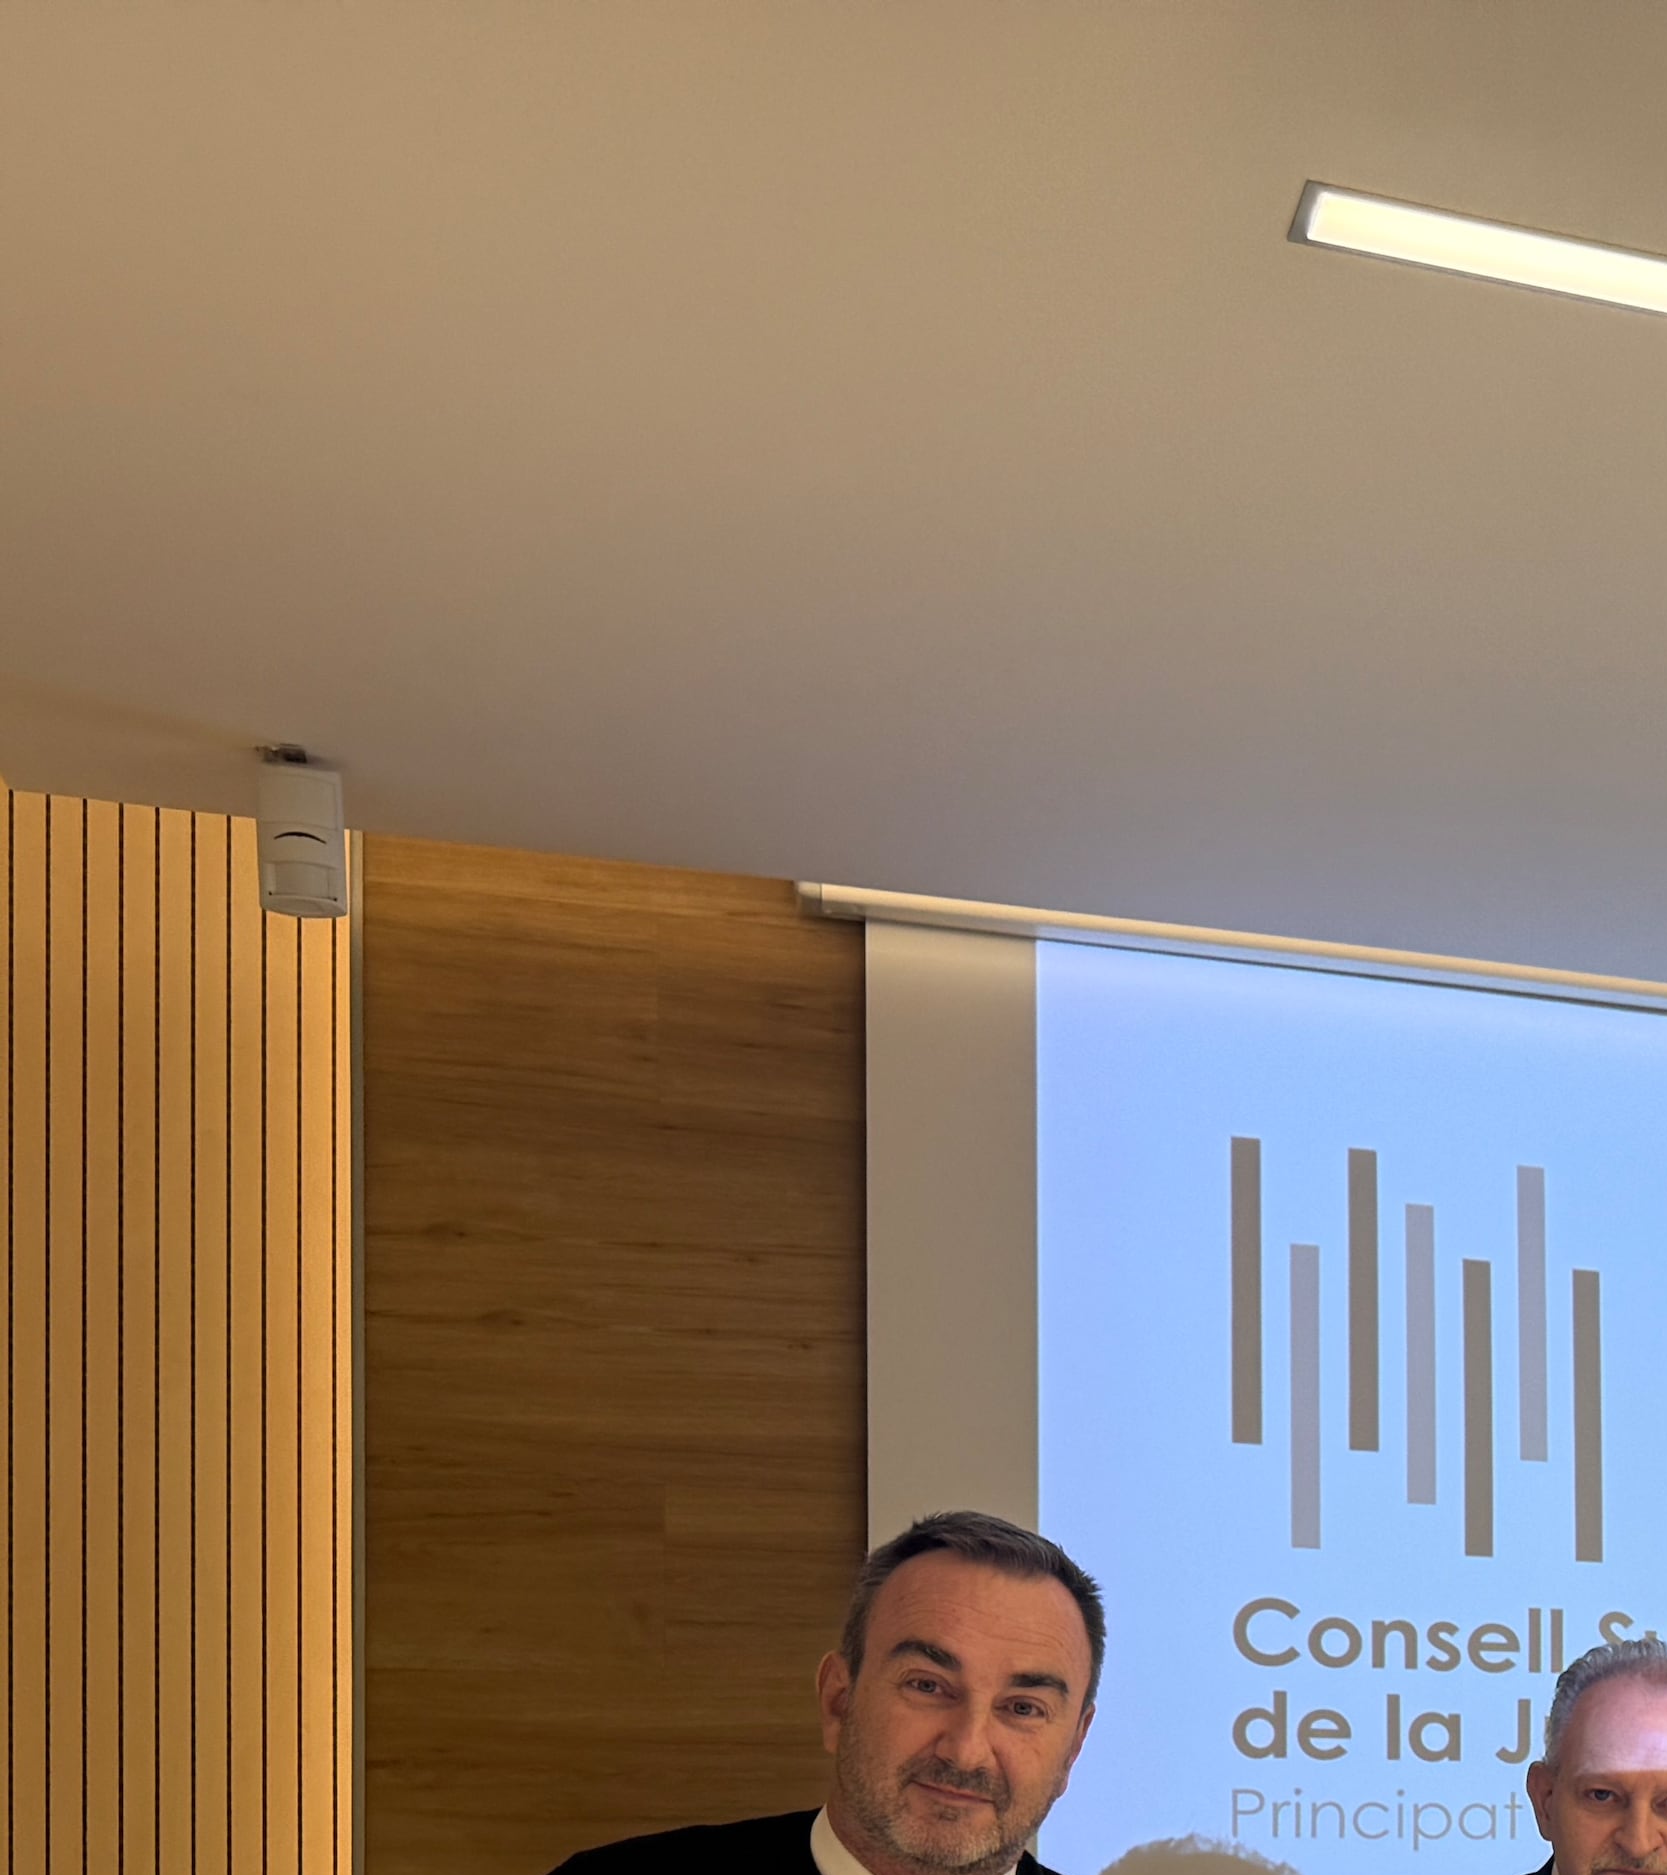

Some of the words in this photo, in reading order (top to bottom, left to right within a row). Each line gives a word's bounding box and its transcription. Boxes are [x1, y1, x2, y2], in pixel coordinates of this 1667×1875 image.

[1232, 1596, 1564, 1676] Consell
[1232, 1690, 1352, 1761] de
[1386, 1693, 1462, 1763] la
[1231, 1787, 1523, 1851] Principat
